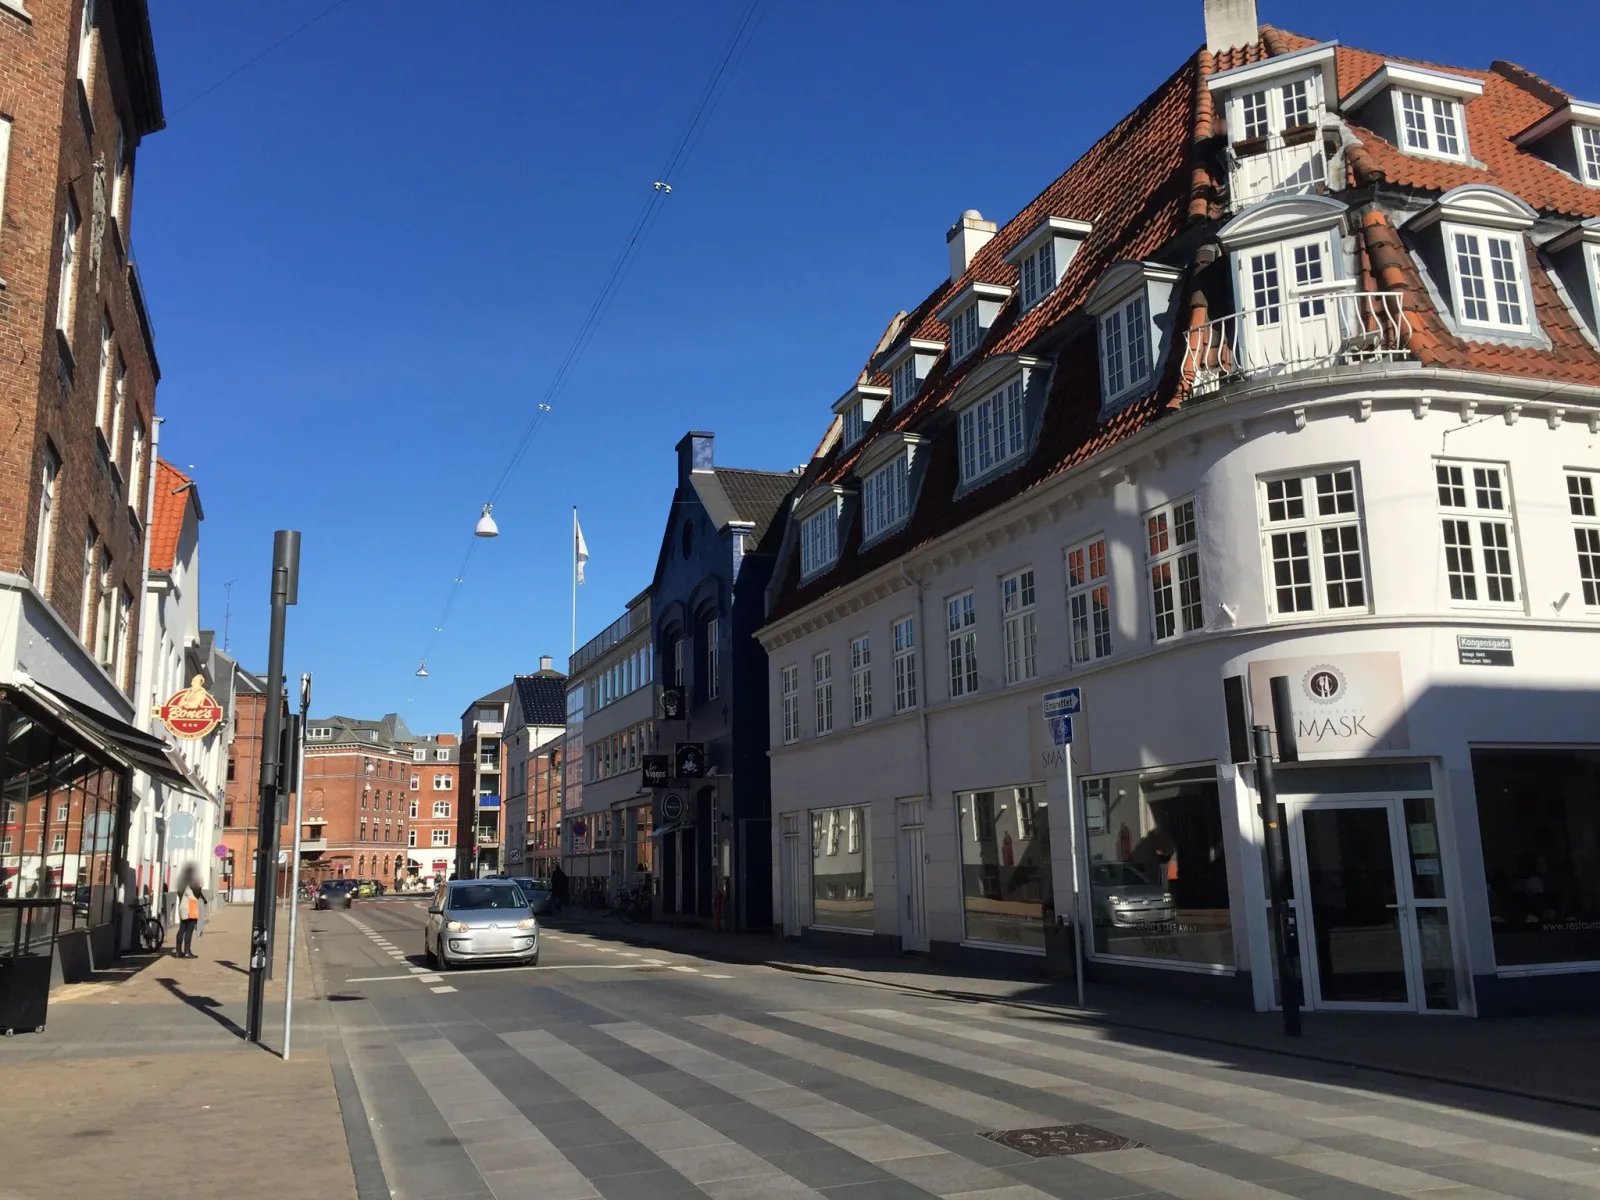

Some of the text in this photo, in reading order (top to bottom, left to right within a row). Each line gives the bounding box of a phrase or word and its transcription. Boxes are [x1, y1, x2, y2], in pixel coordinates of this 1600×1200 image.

[1461, 638, 1510, 649] Kongensgade
[1045, 697, 1073, 711] Ensrettet
[168, 706, 213, 719] Bone's
[1294, 715, 1379, 743] MASK
[1041, 745, 1077, 769] SMAK
[1178, 924, 1197, 932] AWAY
